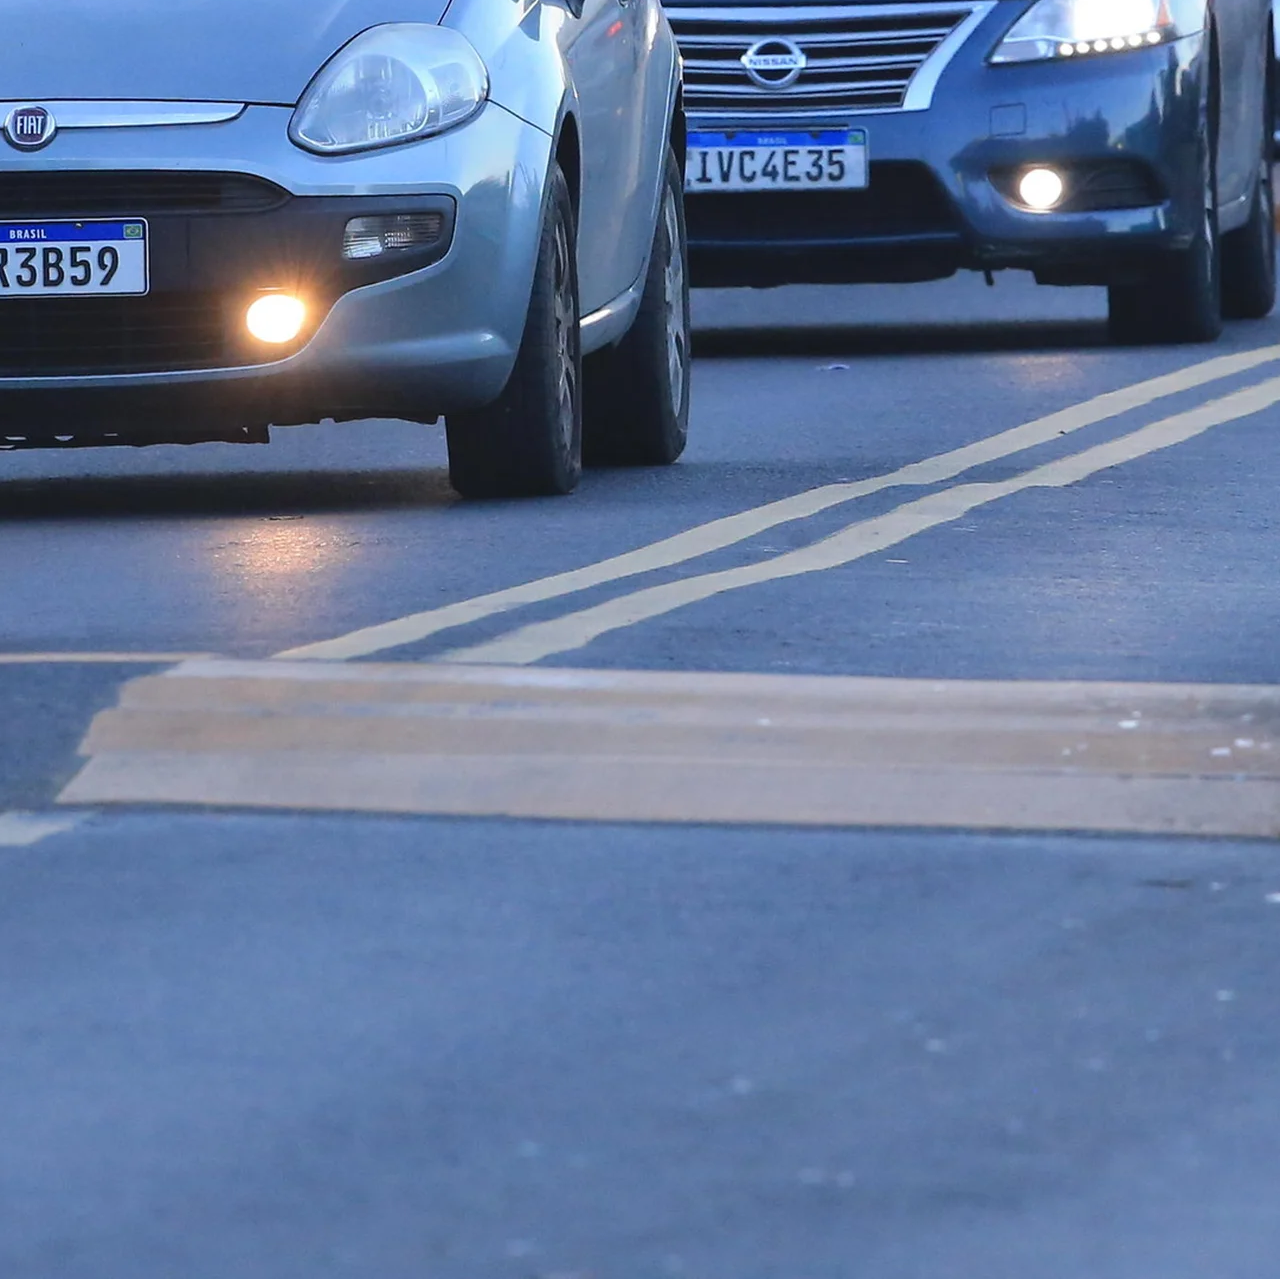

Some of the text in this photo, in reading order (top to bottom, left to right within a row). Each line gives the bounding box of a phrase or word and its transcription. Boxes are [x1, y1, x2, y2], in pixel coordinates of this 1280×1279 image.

[16, 115, 45, 135] FIAT
[696, 149, 846, 184] IVC4E35
[9, 229, 47, 239] BRASIL
